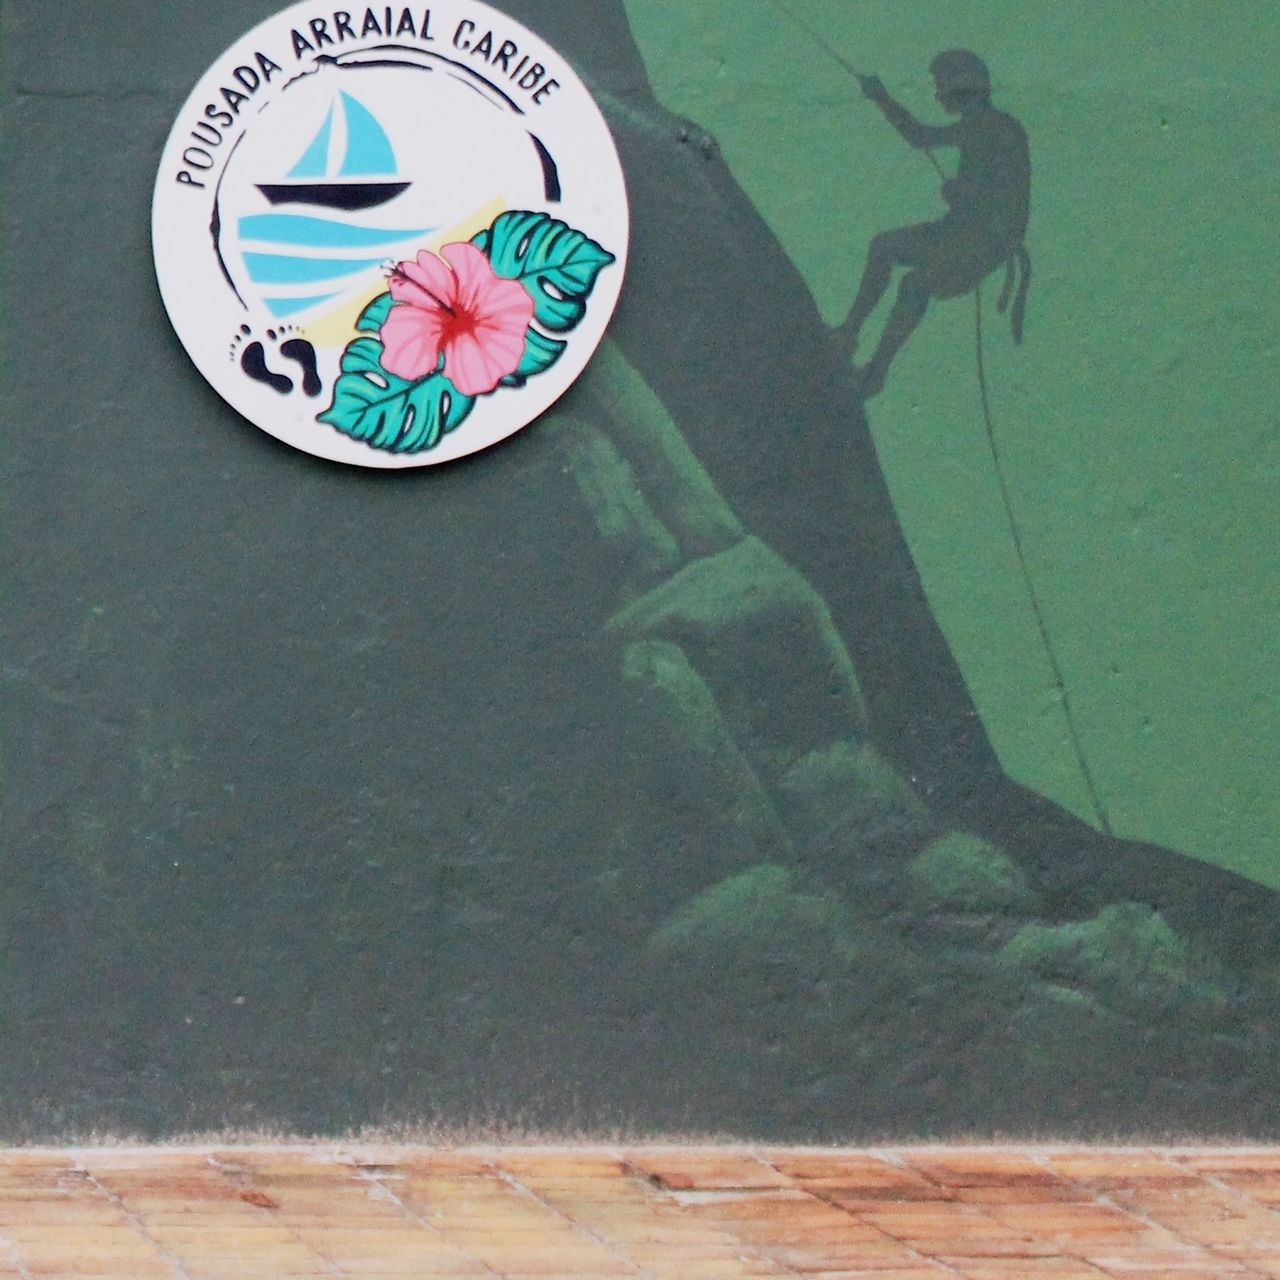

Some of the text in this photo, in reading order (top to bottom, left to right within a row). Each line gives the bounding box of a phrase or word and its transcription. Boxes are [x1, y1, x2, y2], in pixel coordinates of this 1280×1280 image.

[175, 6, 562, 189] POUSADA ARRAIAL CARIBE
